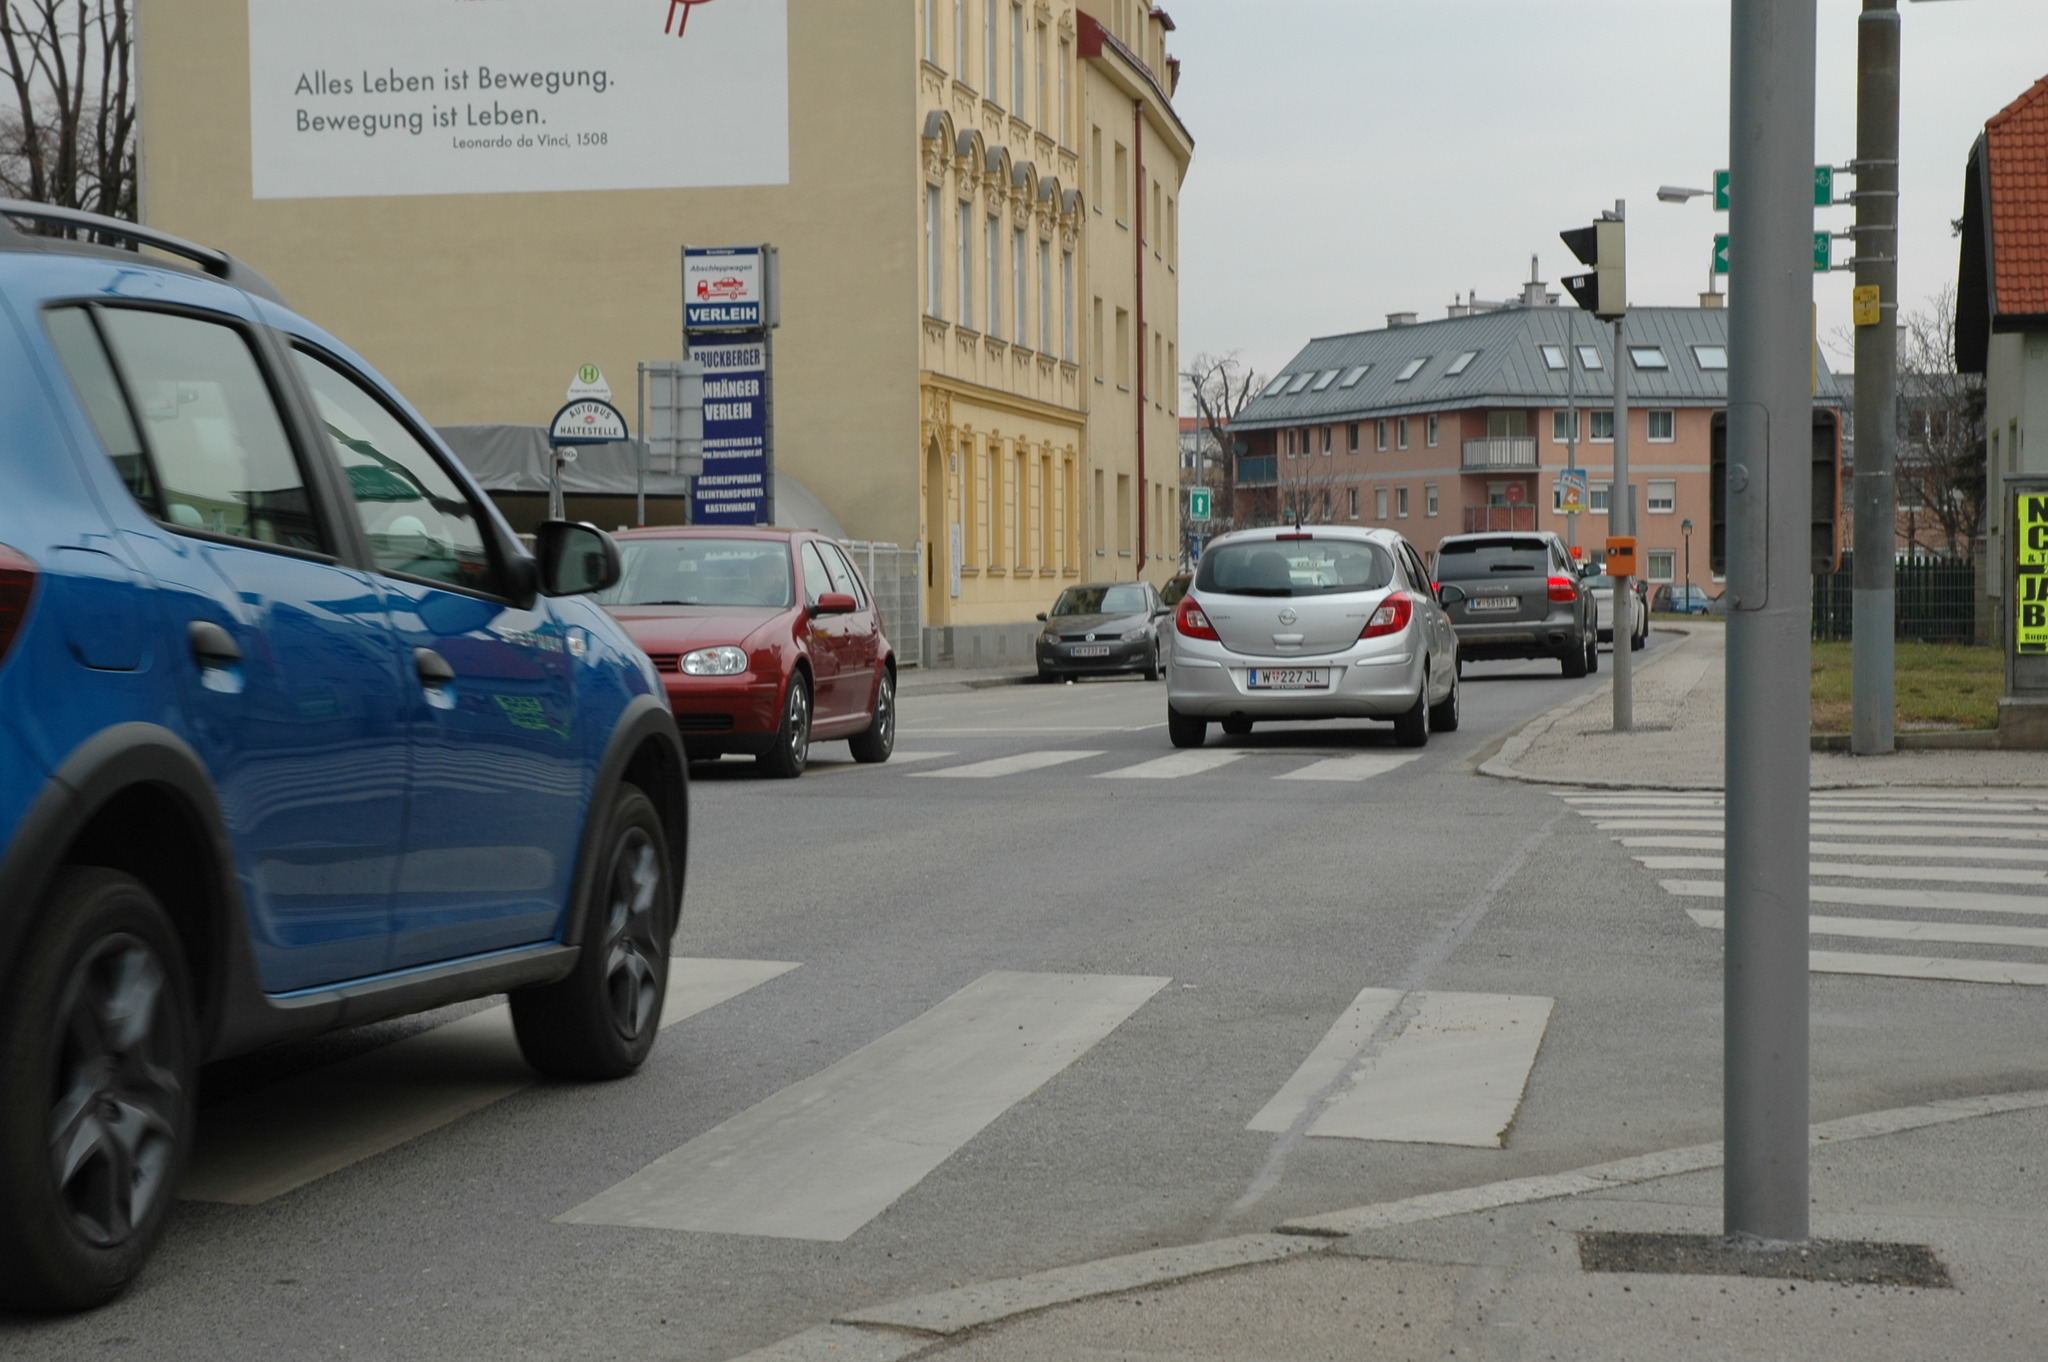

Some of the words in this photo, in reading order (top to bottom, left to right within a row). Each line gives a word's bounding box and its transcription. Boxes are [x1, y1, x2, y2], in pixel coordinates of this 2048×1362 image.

[294, 69, 354, 96] Alles
[363, 67, 435, 94] Leben
[444, 67, 469, 91] ist
[478, 66, 615, 94] Bewegung.
[296, 108, 424, 137] Bewegung
[432, 104, 458, 127] ist
[467, 100, 546, 126] Leben.
[453, 134, 513, 149] Leonardo
[516, 134, 533, 148] da
[537, 133, 572, 148] Vinci,
[577, 132, 608, 146] 1508
[689, 263, 753, 273] Abschleppwagen
[688, 305, 758, 322] VERLEIH
[694, 349, 761, 368] BRUCKBERGER
[583, 367, 594, 380] H
[702, 378, 760, 399] NHÄNGER
[569, 403, 612, 420] AUTOBUS
[704, 401, 752, 420] VERLEIH
[560, 425, 618, 437] HALTESTELLE
[753, 436, 763, 446] 24
[698, 473, 762, 486] ABSCHLEPPWAGEN
[704, 501, 756, 514] KASTENWAGEN
[1261, 670, 1272, 684] W
[1280, 669, 1303, 684] 227
[1306, 669, 1320, 682] JL
